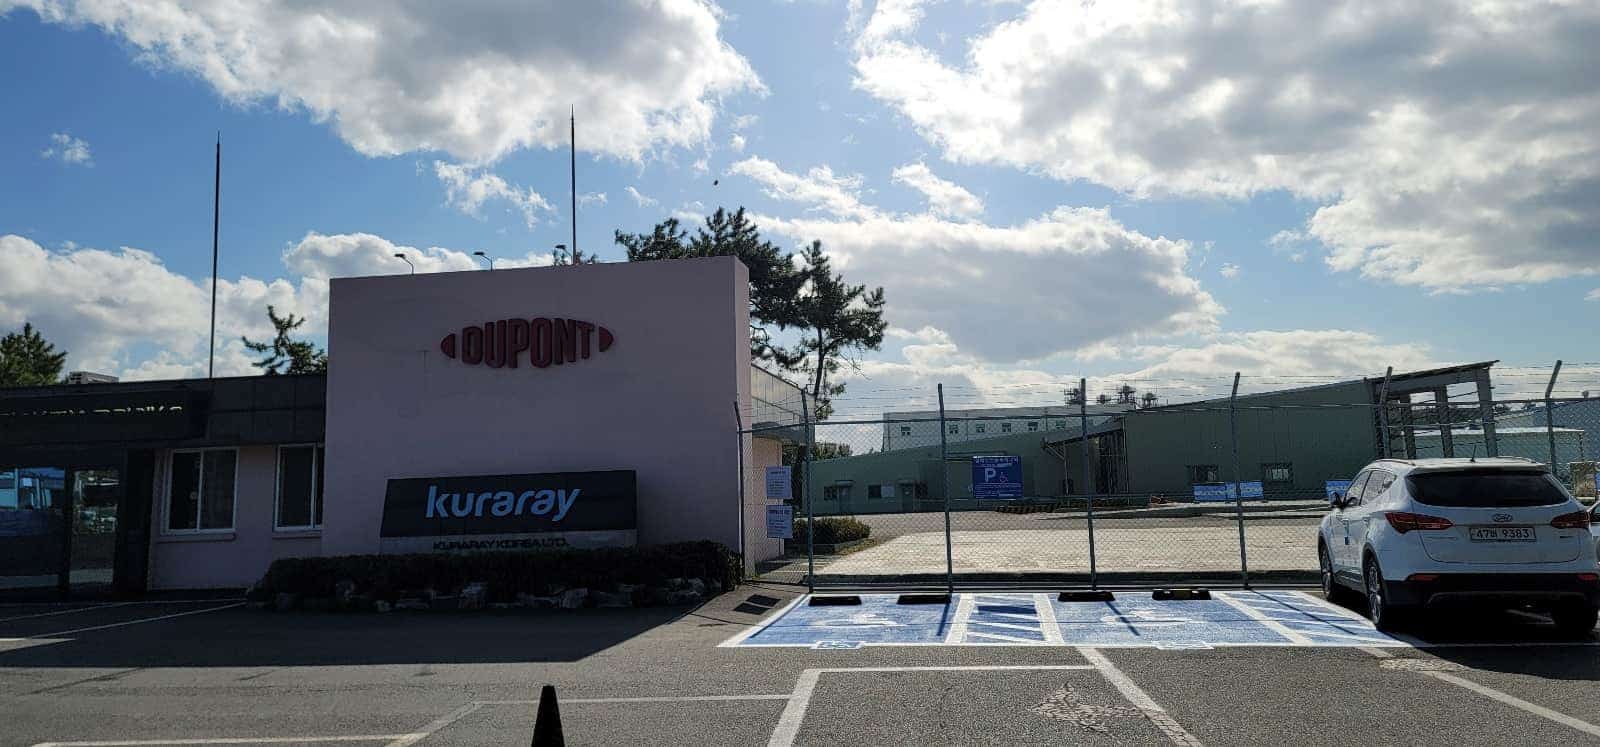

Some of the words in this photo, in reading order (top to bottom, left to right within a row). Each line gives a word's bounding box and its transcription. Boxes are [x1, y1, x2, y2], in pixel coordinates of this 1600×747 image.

[461, 317, 595, 369] DUPONT
[984, 467, 997, 483] P
[424, 482, 582, 523] kuraray
[1502, 528, 1530, 538] 9383
[433, 539, 495, 551] KURARAY
[496, 538, 541, 550] KOREA
